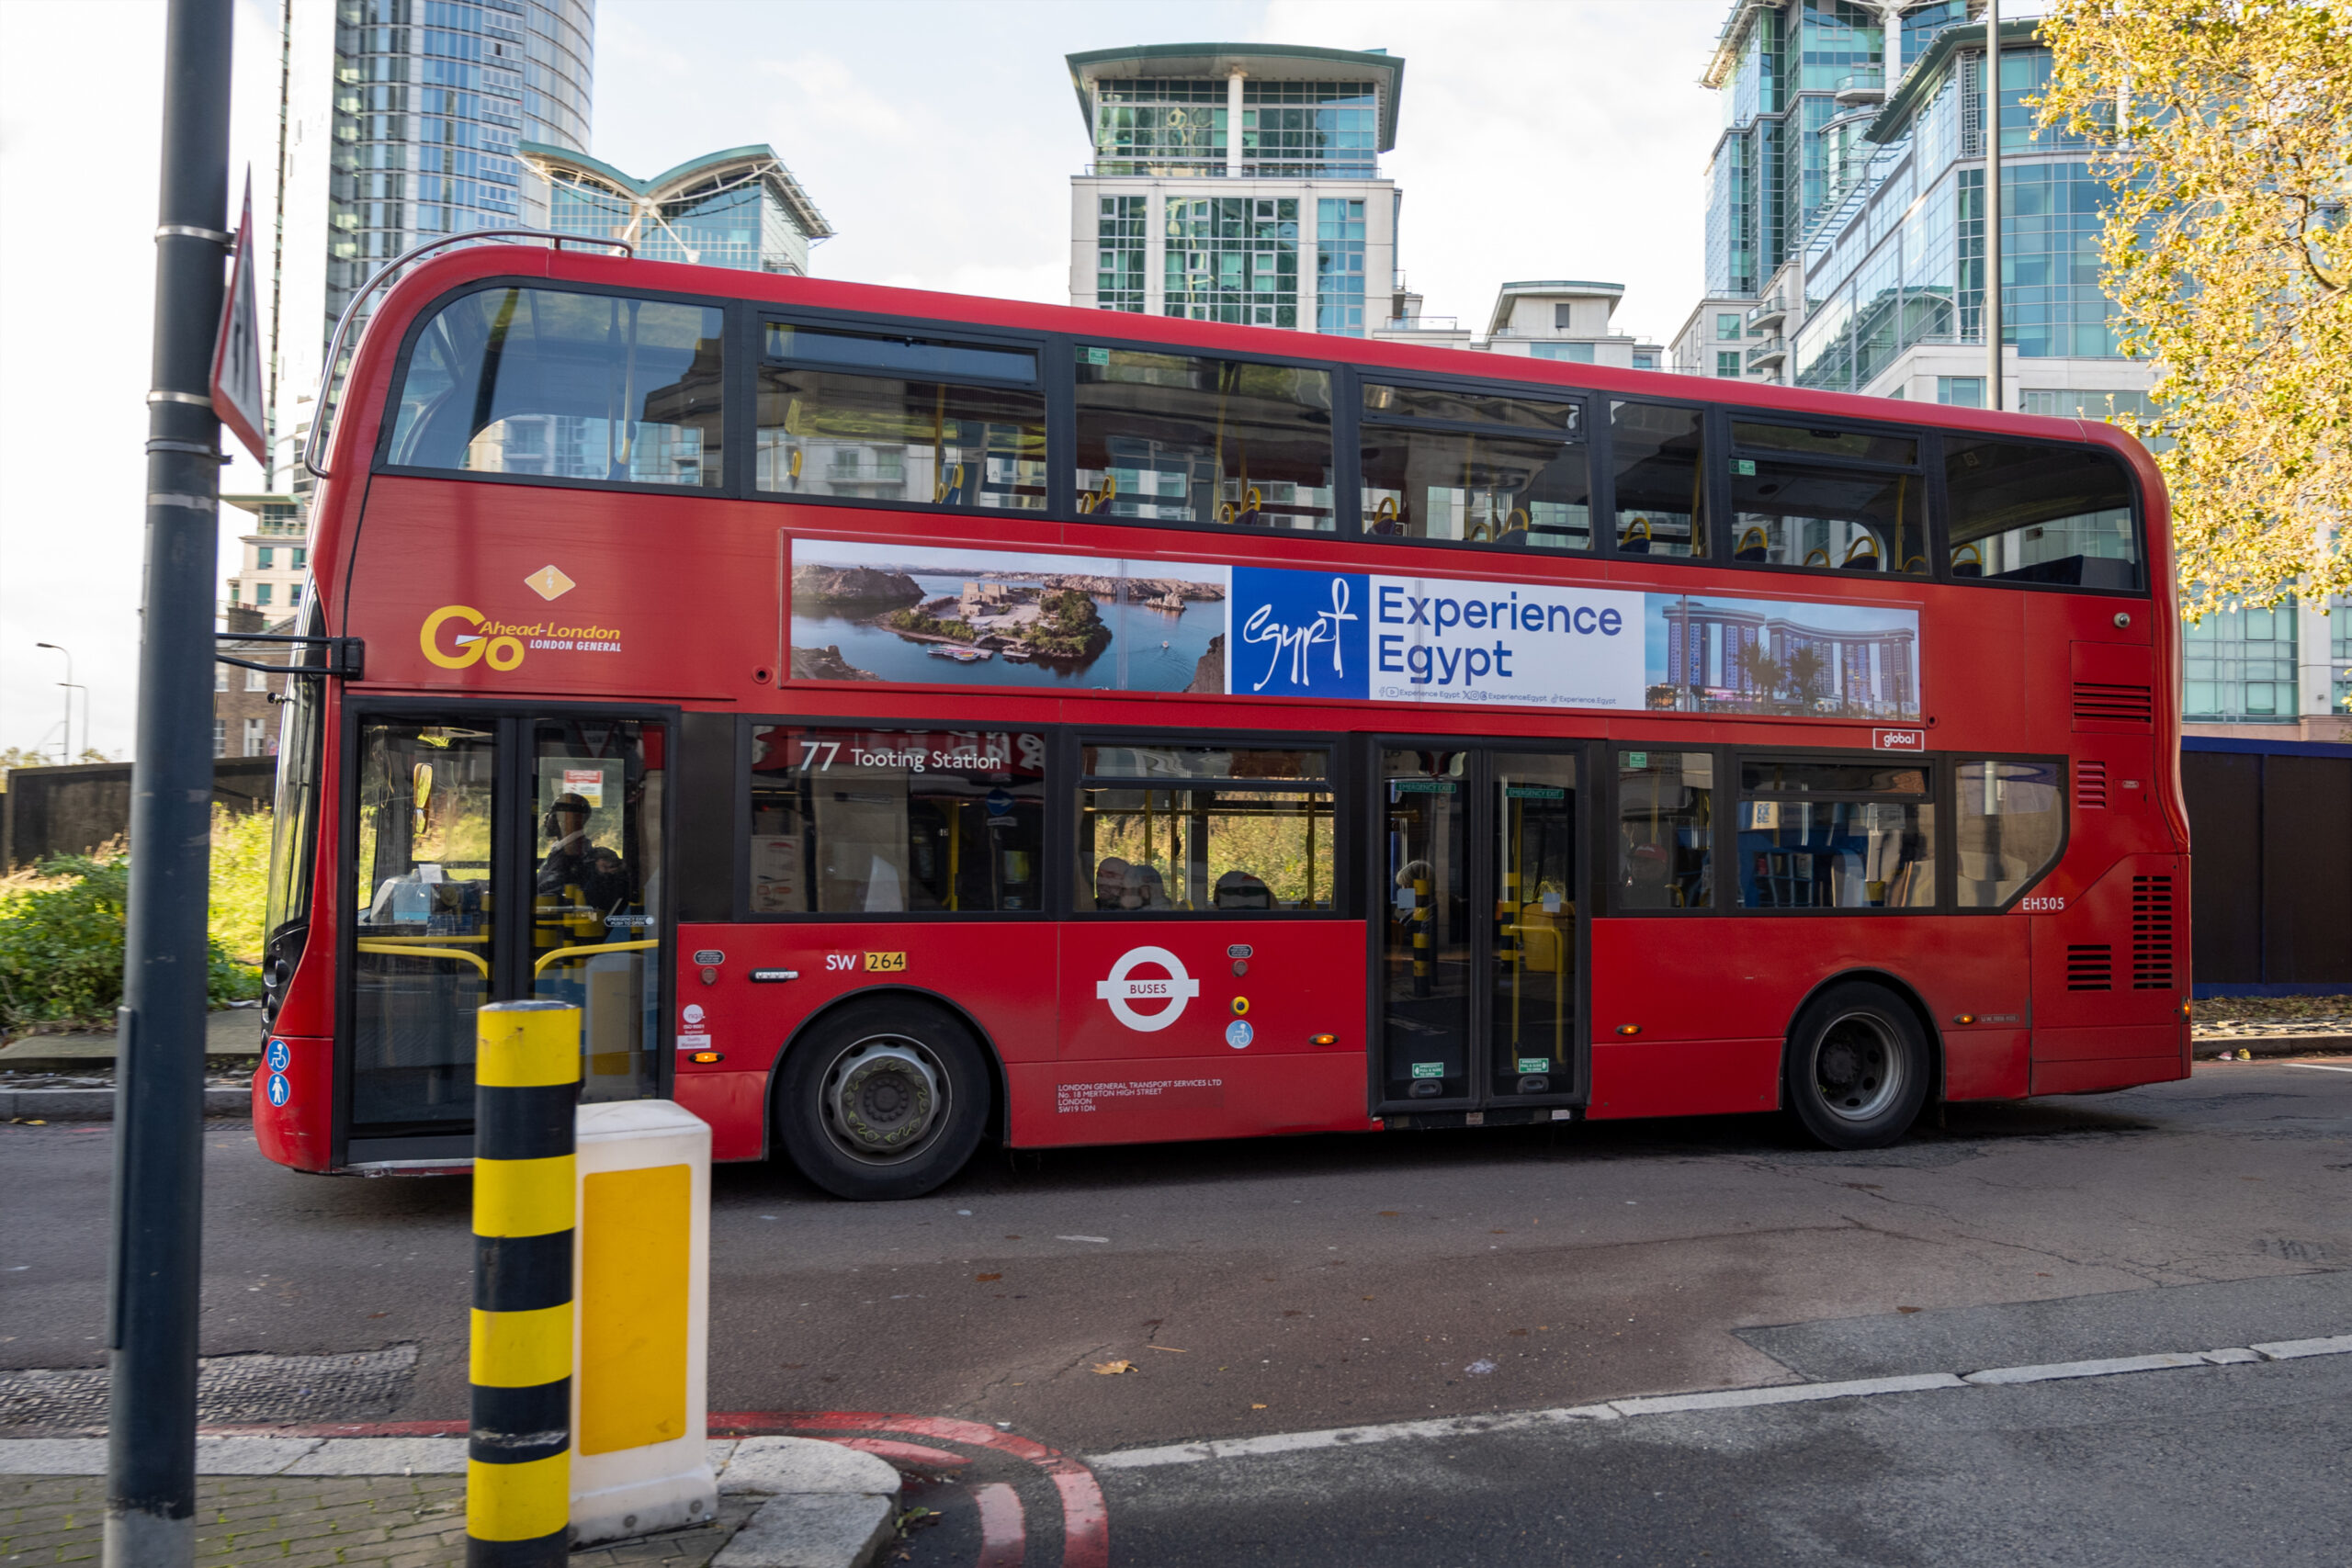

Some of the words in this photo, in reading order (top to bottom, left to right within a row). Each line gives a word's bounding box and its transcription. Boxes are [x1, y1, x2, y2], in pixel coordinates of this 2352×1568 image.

[1379, 586, 1623, 637] Experience
[420, 604, 525, 671] Go
[479, 621, 621, 640] Ahead-London
[530, 639, 573, 650] LONDON
[576, 641, 622, 652] GENERAL
[1379, 635, 1513, 685] Egypt
[1400, 689, 1438, 698] Experience
[1440, 691, 1461, 700] Egypt
[1883, 732, 1915, 748] global
[800, 741, 841, 772] 77
[851, 749, 925, 773] Tooting
[932, 750, 1001, 770] Station
[2022, 897, 2064, 910] EH305
[826, 954, 856, 970] SW
[869, 953, 904, 969] 264
[1130, 984, 1167, 994] BUSES
[1058, 1084, 1092, 1092] LONDON
[1093, 1082, 1127, 1090] GENERAL
[1129, 1080, 1172, 1089] TRANSPORT
[1207, 1078, 1222, 1087] LTD
[1082, 1089, 1114, 1098] MERTON
[1058, 1105, 1079, 1113] SW19
